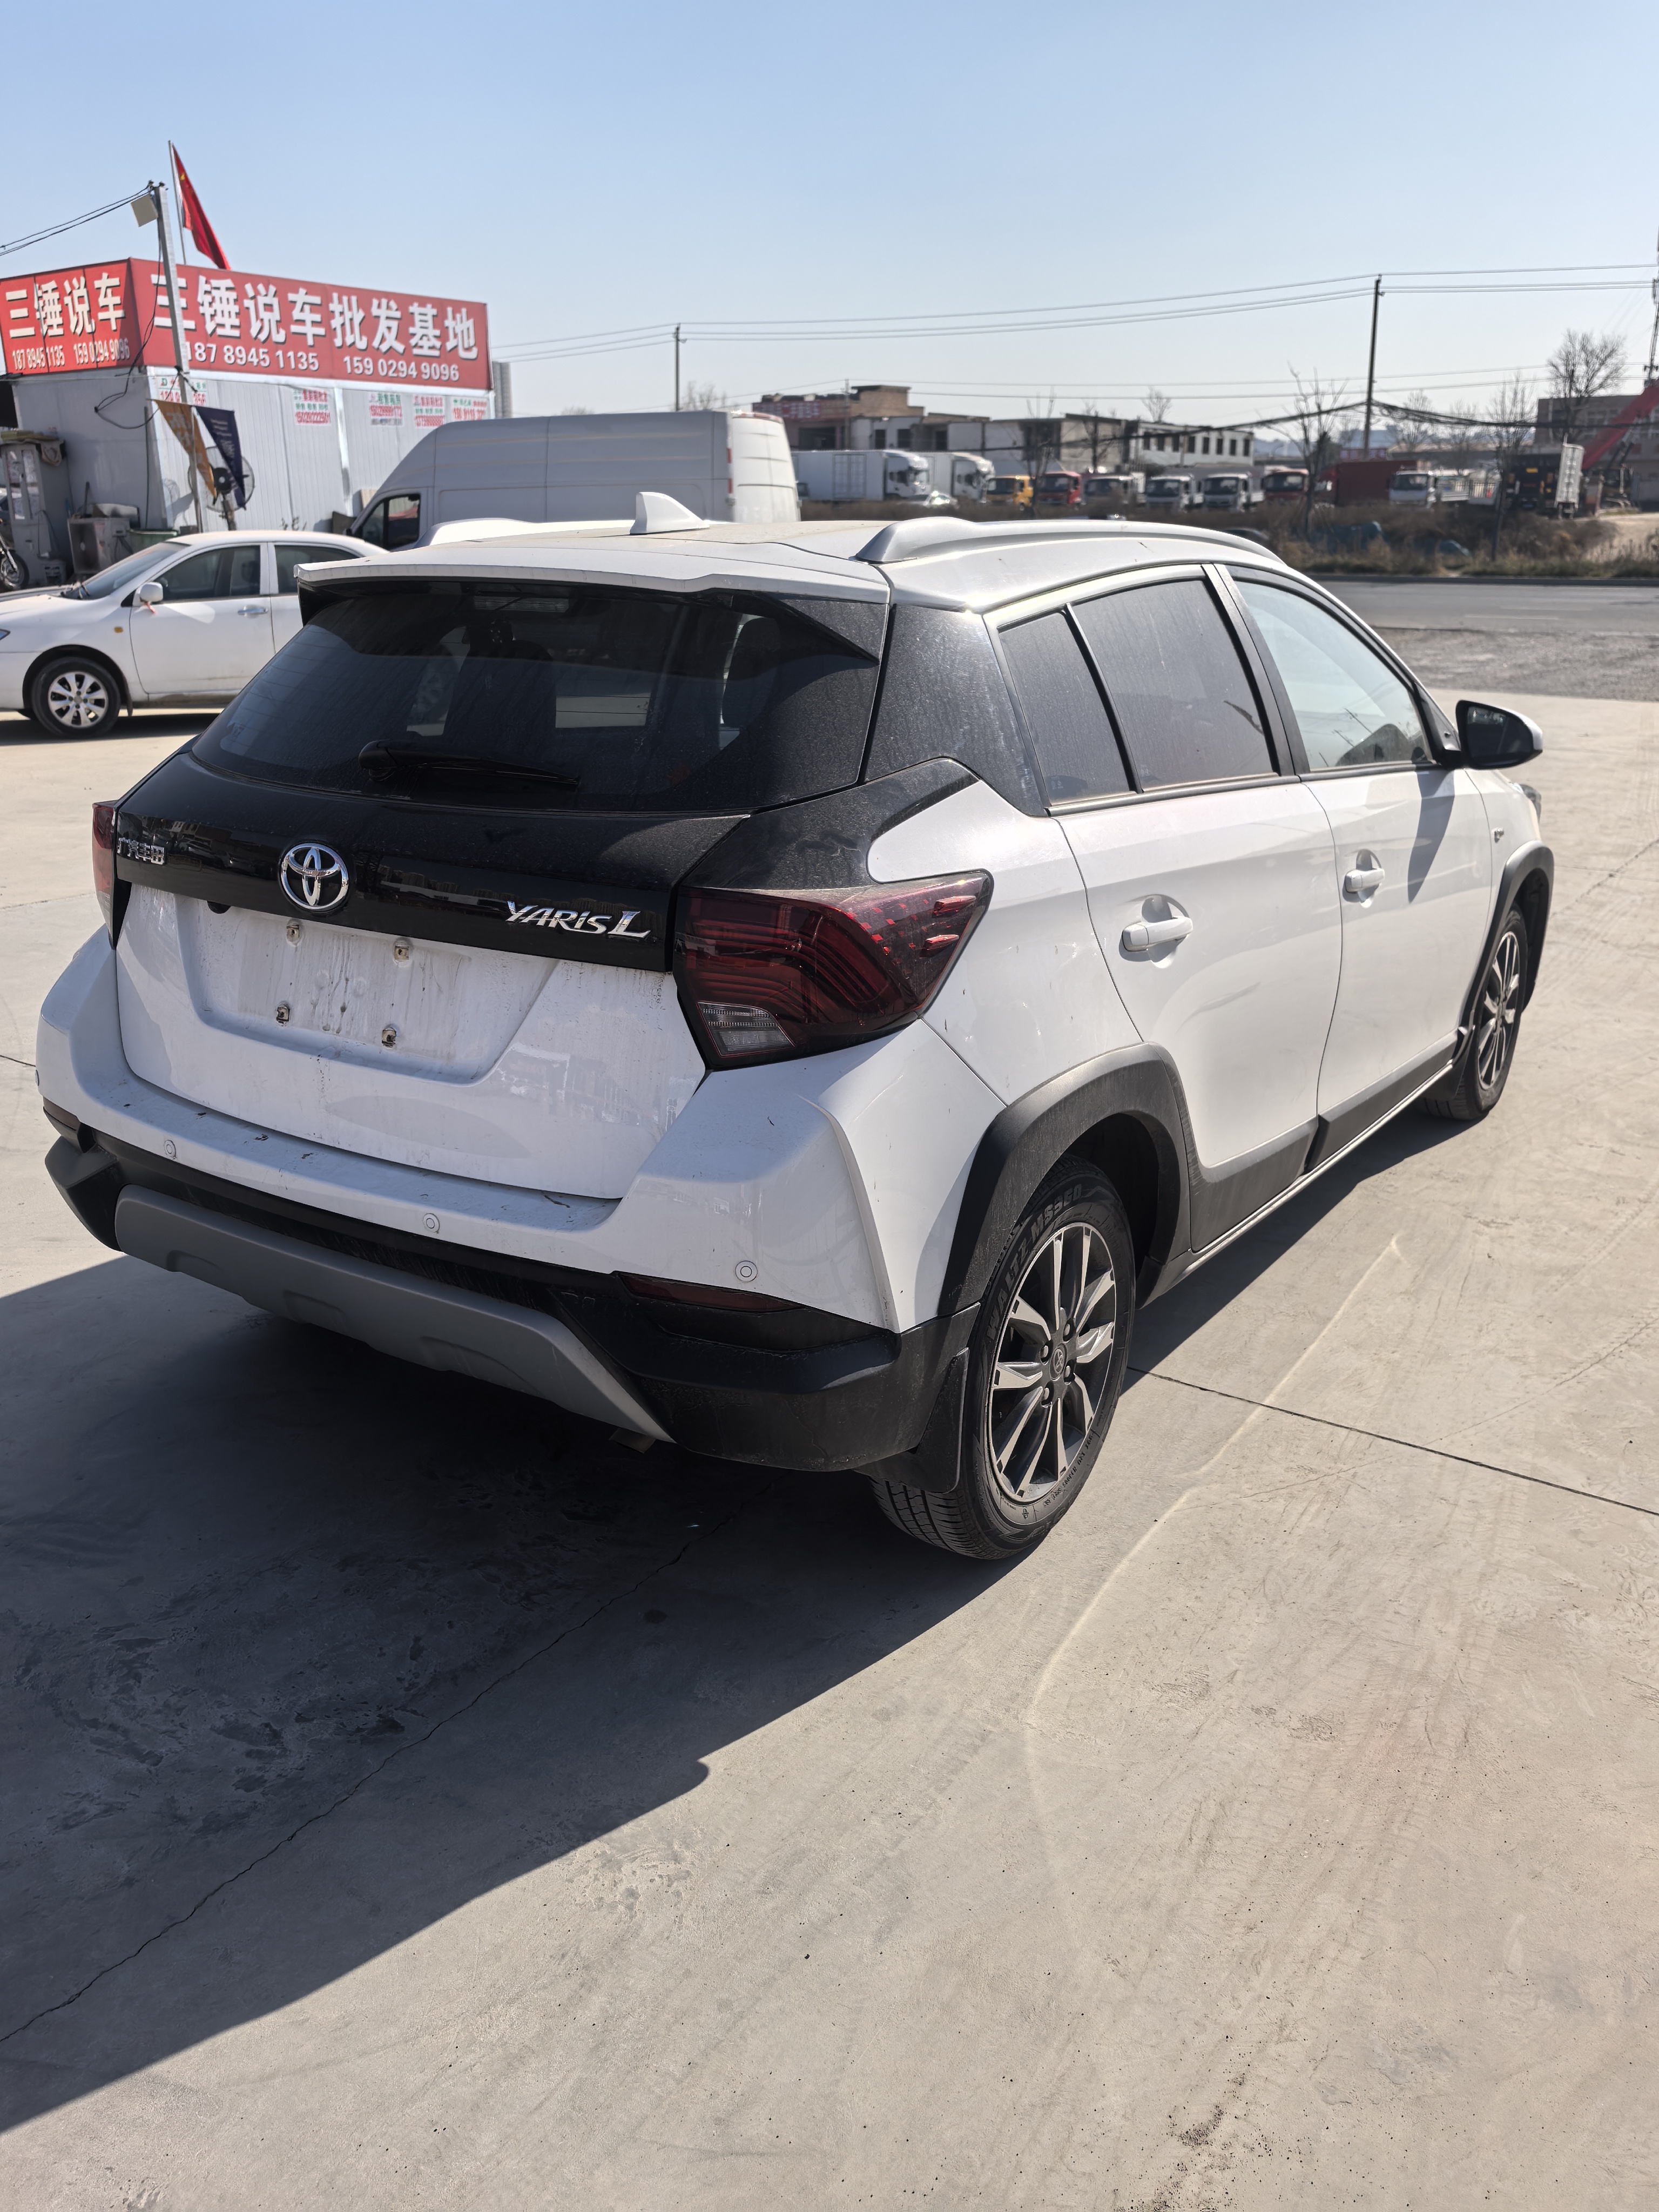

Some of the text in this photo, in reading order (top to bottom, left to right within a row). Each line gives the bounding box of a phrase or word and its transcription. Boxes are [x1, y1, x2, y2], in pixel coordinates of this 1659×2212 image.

[5, 272, 125, 339] 三锤说车
[151, 274, 478, 360] 三锤说车批发基地
[223, 345, 271, 367] 8945
[275, 350, 319, 372] 1135
[343, 356, 374, 376] 159
[378, 359, 417, 379] 0294
[421, 362, 460, 382] 9096
[505, 900, 651, 938] YARIS L
